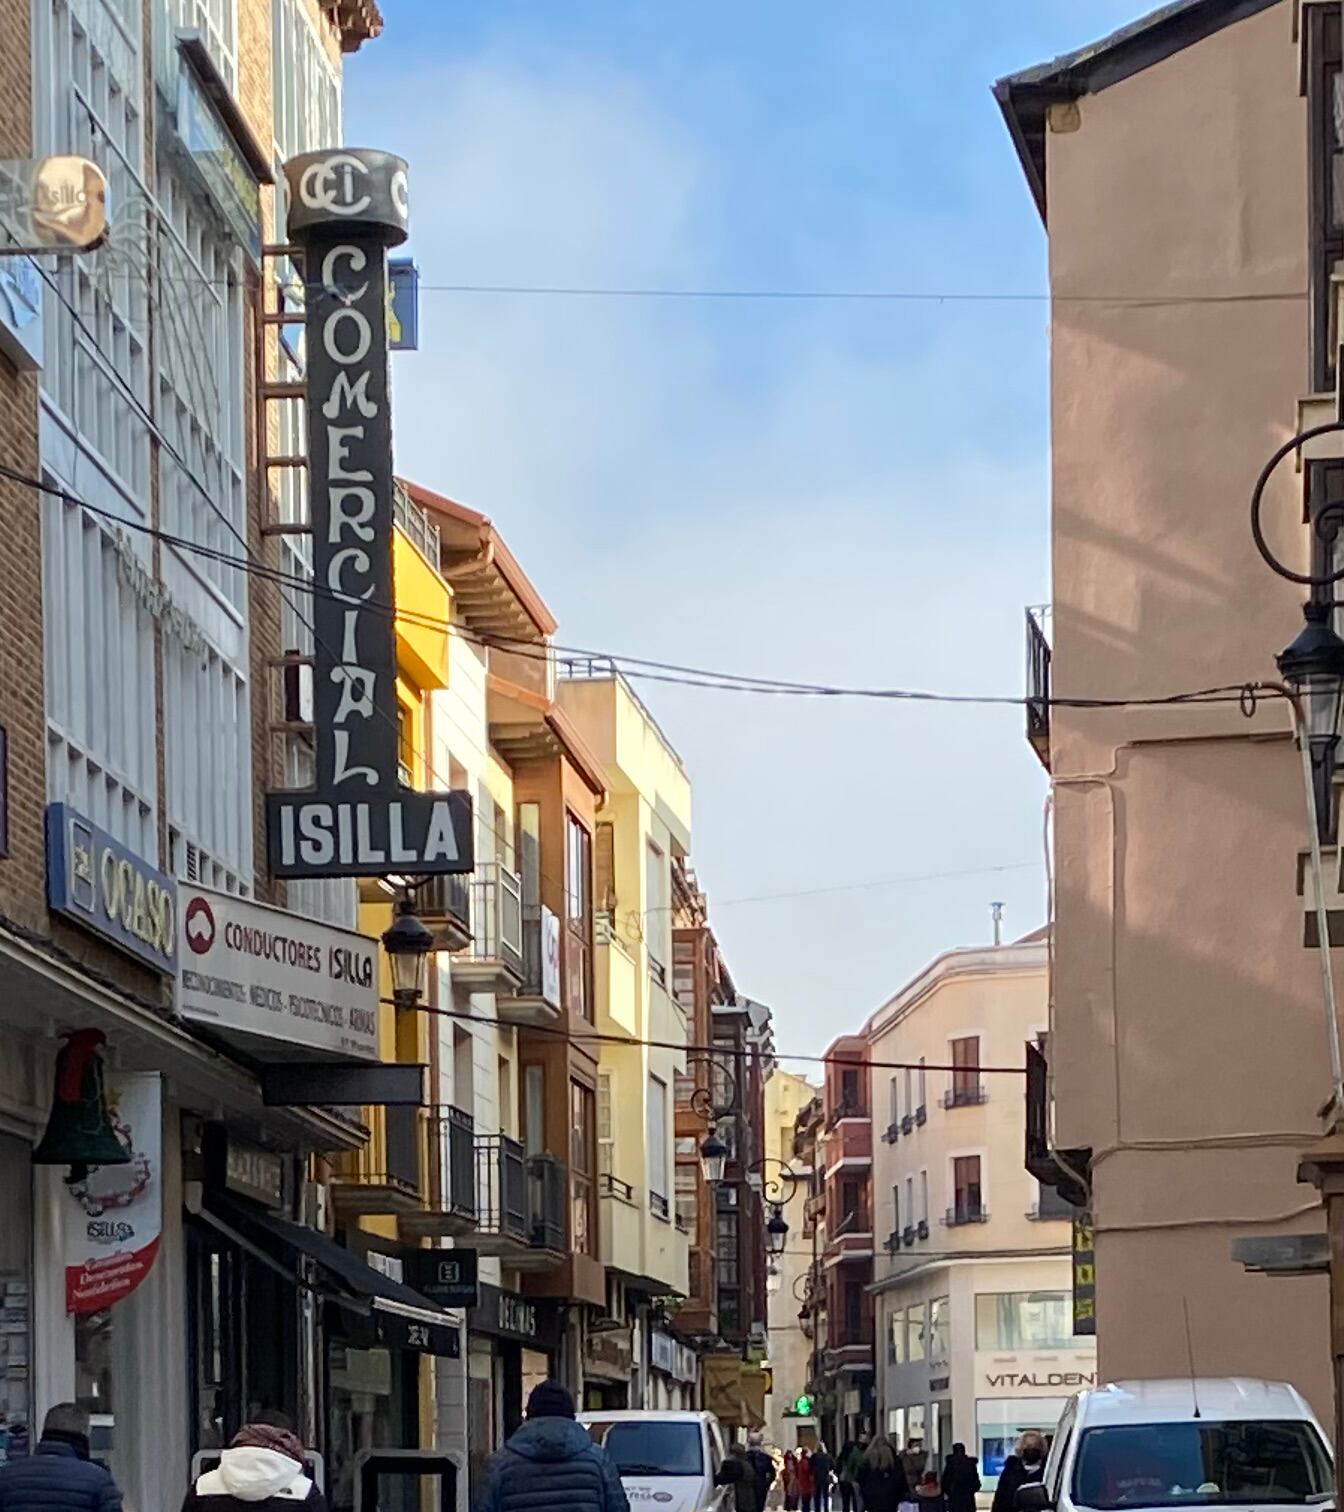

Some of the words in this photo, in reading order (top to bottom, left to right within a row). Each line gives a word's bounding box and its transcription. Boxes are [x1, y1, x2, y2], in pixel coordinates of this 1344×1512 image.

[320, 244, 378, 787] COMERCIAL
[279, 800, 460, 867] ISILLA
[100, 847, 175, 958] OCASO
[224, 920, 321, 973] CONDUCTORES
[327, 945, 373, 990] ISILLA
[985, 1371, 1097, 1387] VITALDEN
